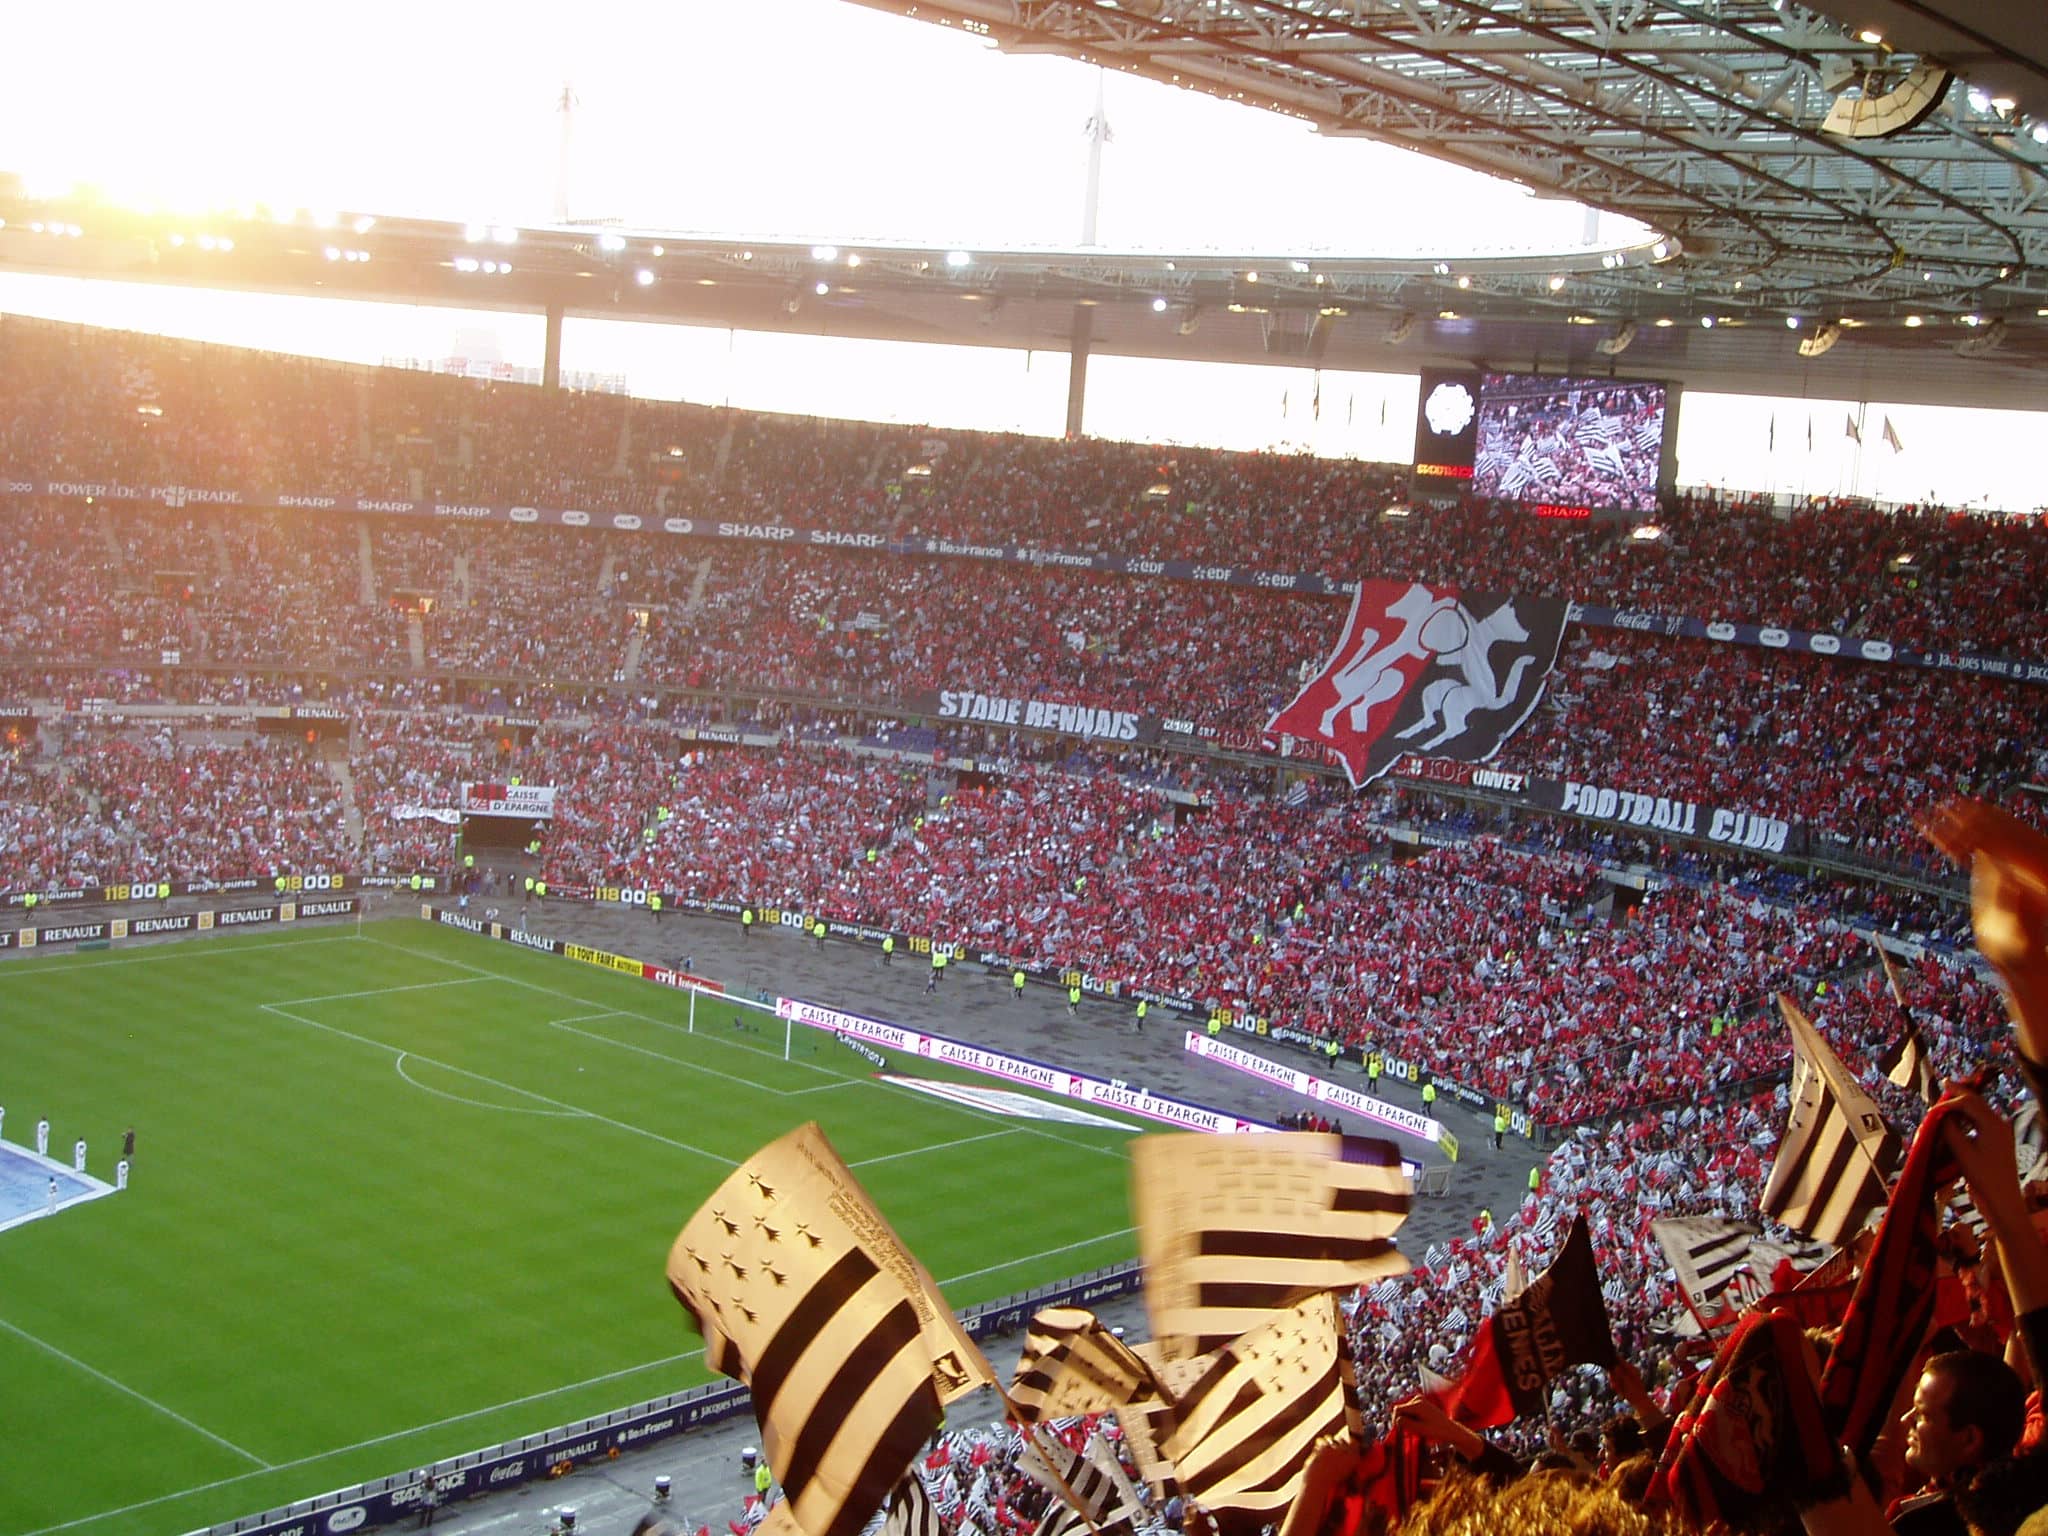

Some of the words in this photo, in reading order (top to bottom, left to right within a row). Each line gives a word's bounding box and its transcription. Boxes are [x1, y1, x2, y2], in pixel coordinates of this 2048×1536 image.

[49, 482, 142, 498] POWERDE
[151, 486, 242, 504] POERADE
[278, 494, 336, 508] SHARP
[357, 499, 414, 513] SHARP
[435, 503, 491, 518] SHARP
[718, 522, 795, 541] SHARP
[811, 529, 886, 548] SHARP
[938, 690, 1022, 727] STADE
[1024, 699, 1140, 741] RENNAIS
[1560, 781, 1697, 836] FOOTBALL
[1708, 807, 1791, 853] CLUB
[221, 908, 274, 925] RENAULT
[302, 900, 353, 917] RENAULT
[135, 917, 192, 933] RENAULT
[440, 911, 483, 932] RENAULT
[44, 925, 104, 942] RENAULT
[510, 928, 556, 952] RENAULT
[577, 946, 595, 962] TOUT
[596, 952, 616, 969] FAIRE
[801, 1006, 837, 1026] CAISSE
[940, 1044, 981, 1065] CAISSE
[1207, 1041, 1239, 1063] CAISSE
[1093, 1085, 1137, 1108] CAISSE
[1327, 1086, 1362, 1108] CAISSE
[555, 1439, 599, 1461] RENAULT
